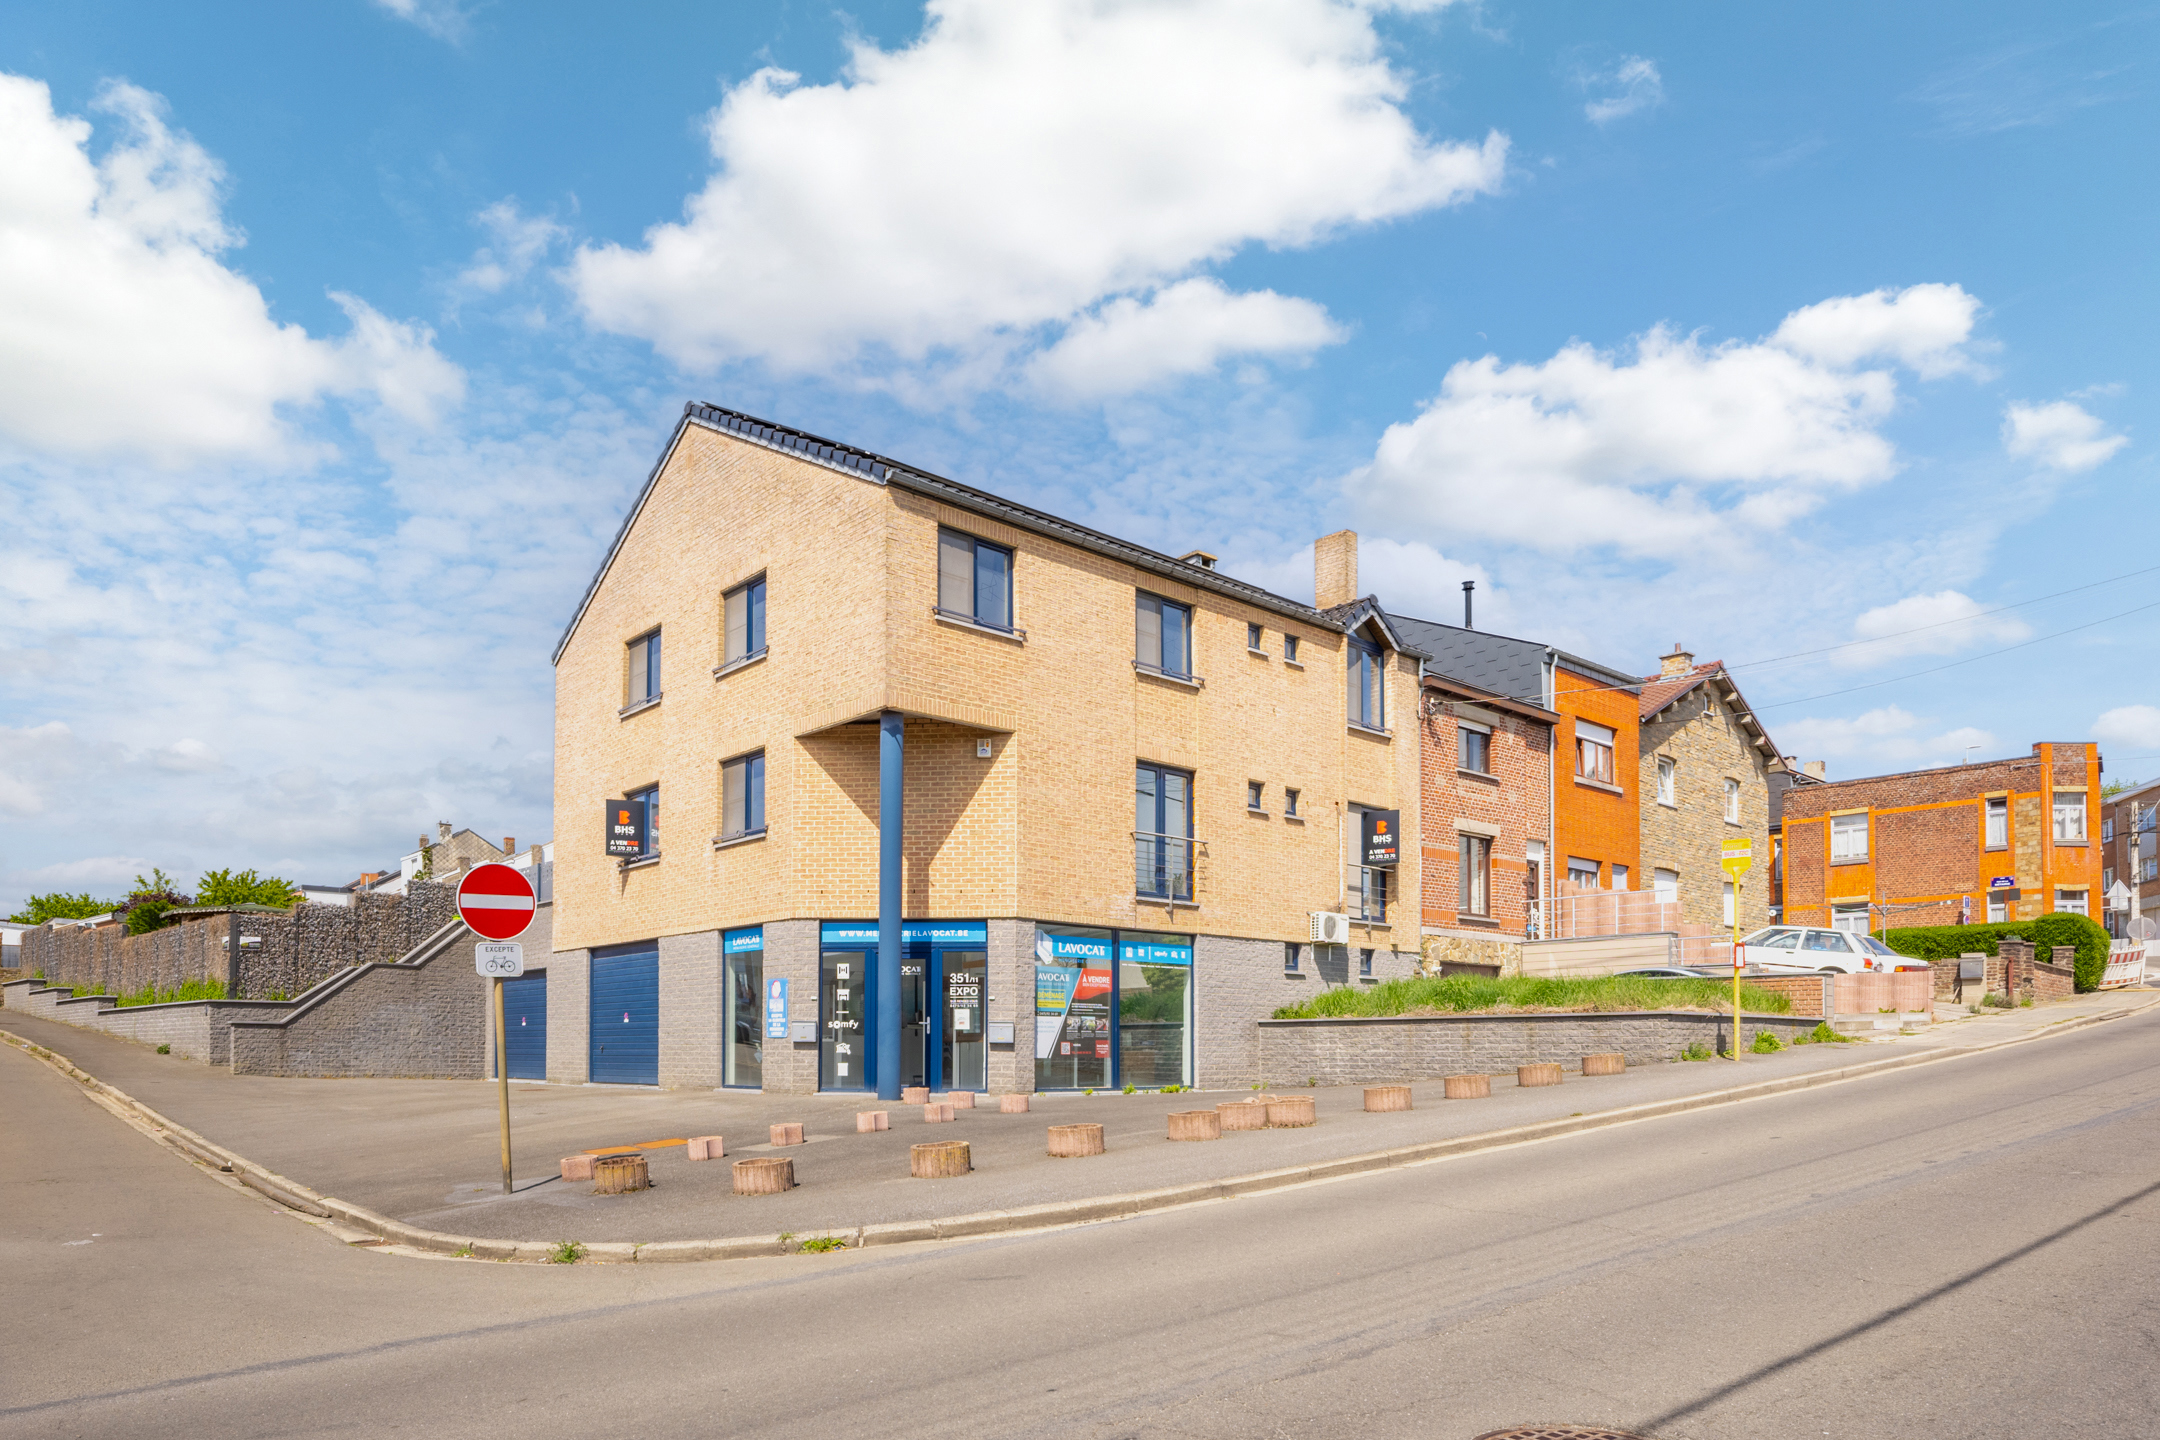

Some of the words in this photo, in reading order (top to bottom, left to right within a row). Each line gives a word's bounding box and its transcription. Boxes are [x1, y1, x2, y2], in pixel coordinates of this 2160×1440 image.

[614, 826, 635, 834] BHS
[1372, 834, 1392, 843] BHS
[1037, 972, 1070, 982] AVOCAT
[1088, 976, 1110, 984] VENDRE
[950, 986, 978, 996] EXPO
[828, 1020, 859, 1029] somfy
